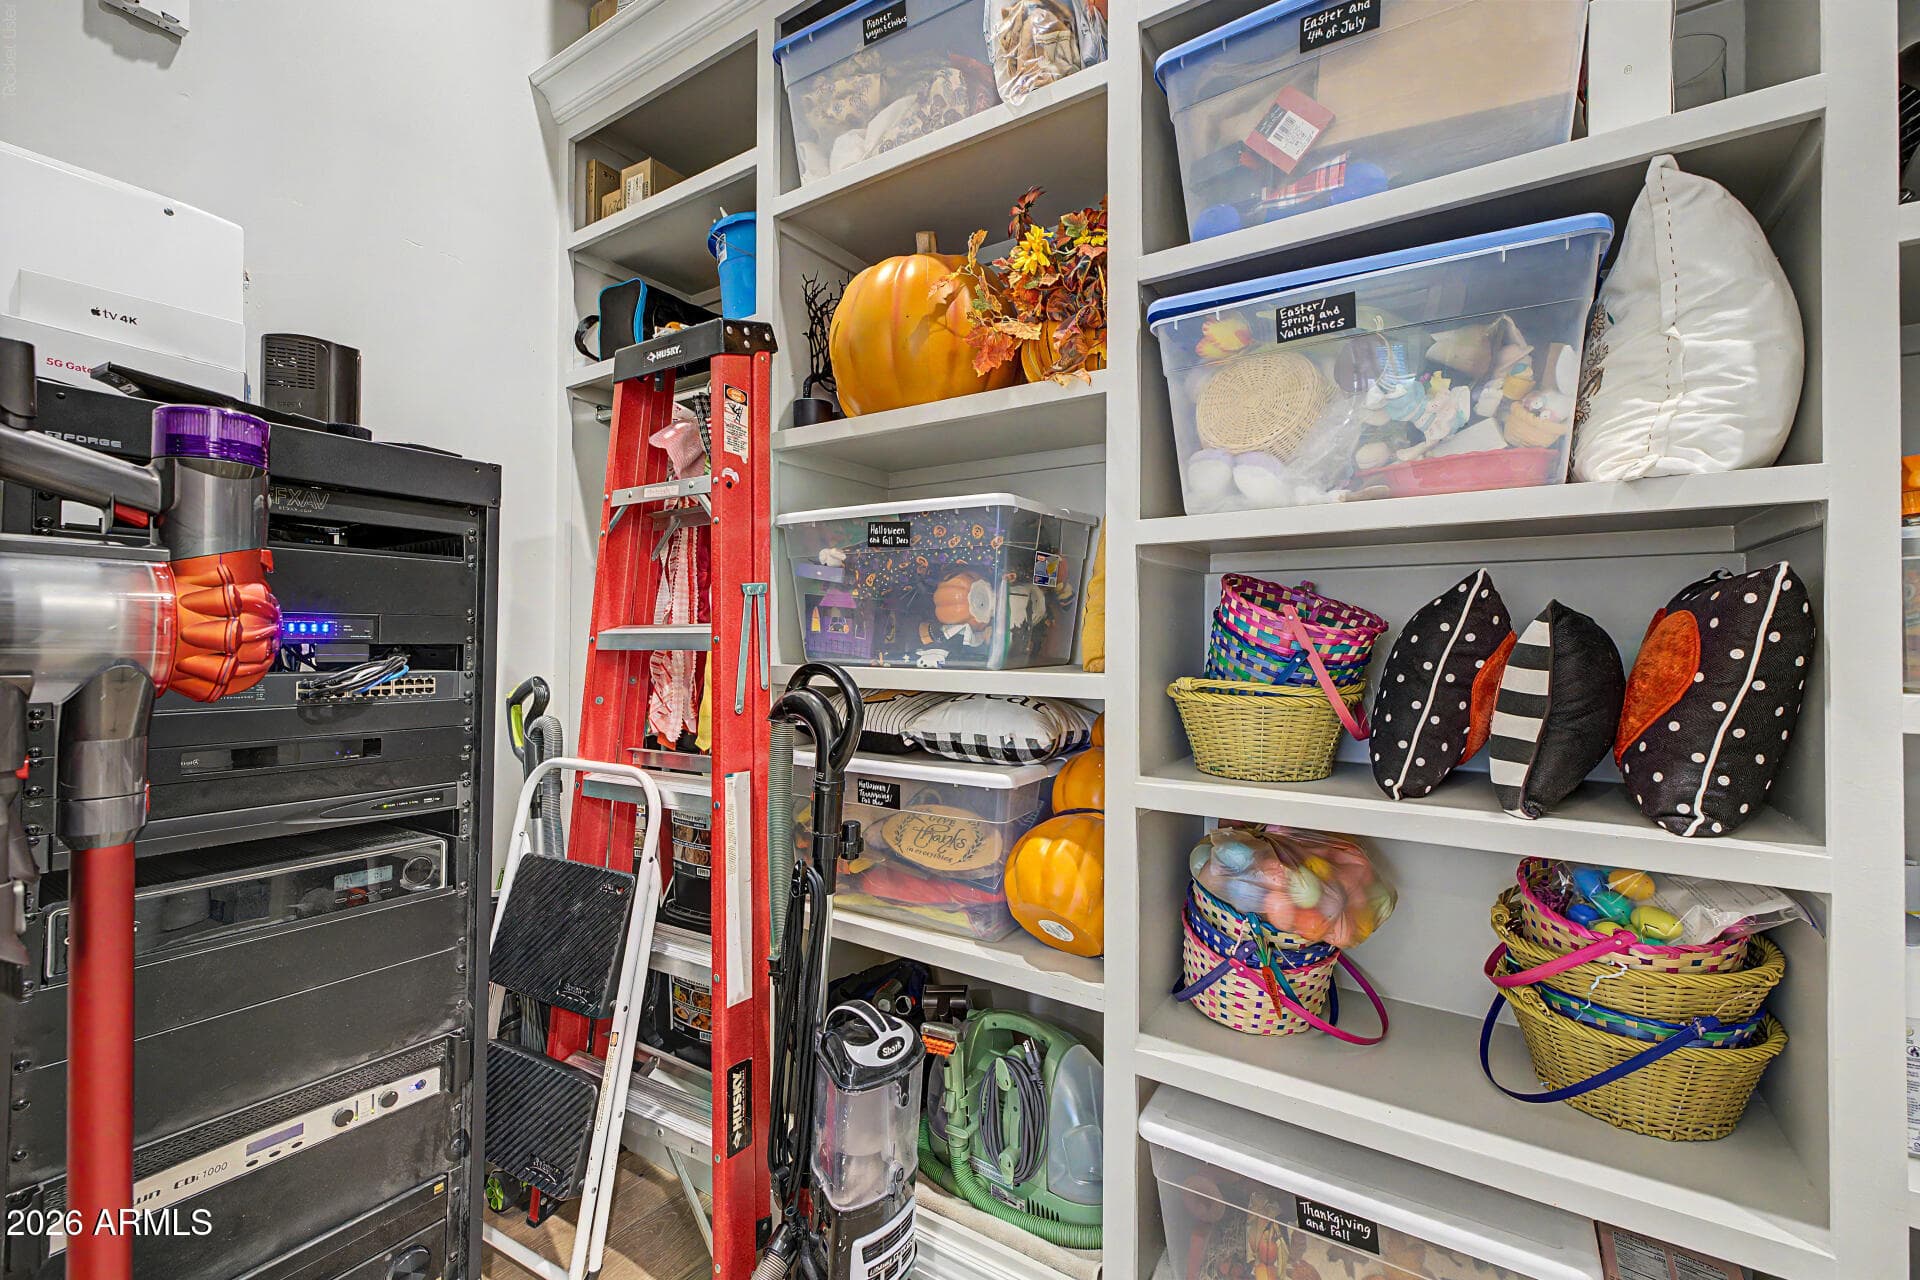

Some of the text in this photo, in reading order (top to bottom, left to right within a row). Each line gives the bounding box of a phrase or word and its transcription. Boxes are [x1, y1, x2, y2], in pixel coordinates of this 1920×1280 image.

[1303, 0, 1371, 32] Easter and
[1325, 24, 1339, 39] of
[1340, 15, 1366, 33] July
[102, 308, 138, 326] tv 4K
[1280, 299, 1326, 319] Easter/
[1320, 305, 1341, 318] and
[1280, 318, 1345, 339] Valentines
[46, 357, 93, 374] 5G Gate
[870, 524, 906, 535] Halloween
[882, 1040, 903, 1057] Shark
[732, 1072, 743, 1132] HUSKY
[202, 1161, 229, 1178] 1000
[1306, 1218, 1350, 1241] and Fall
